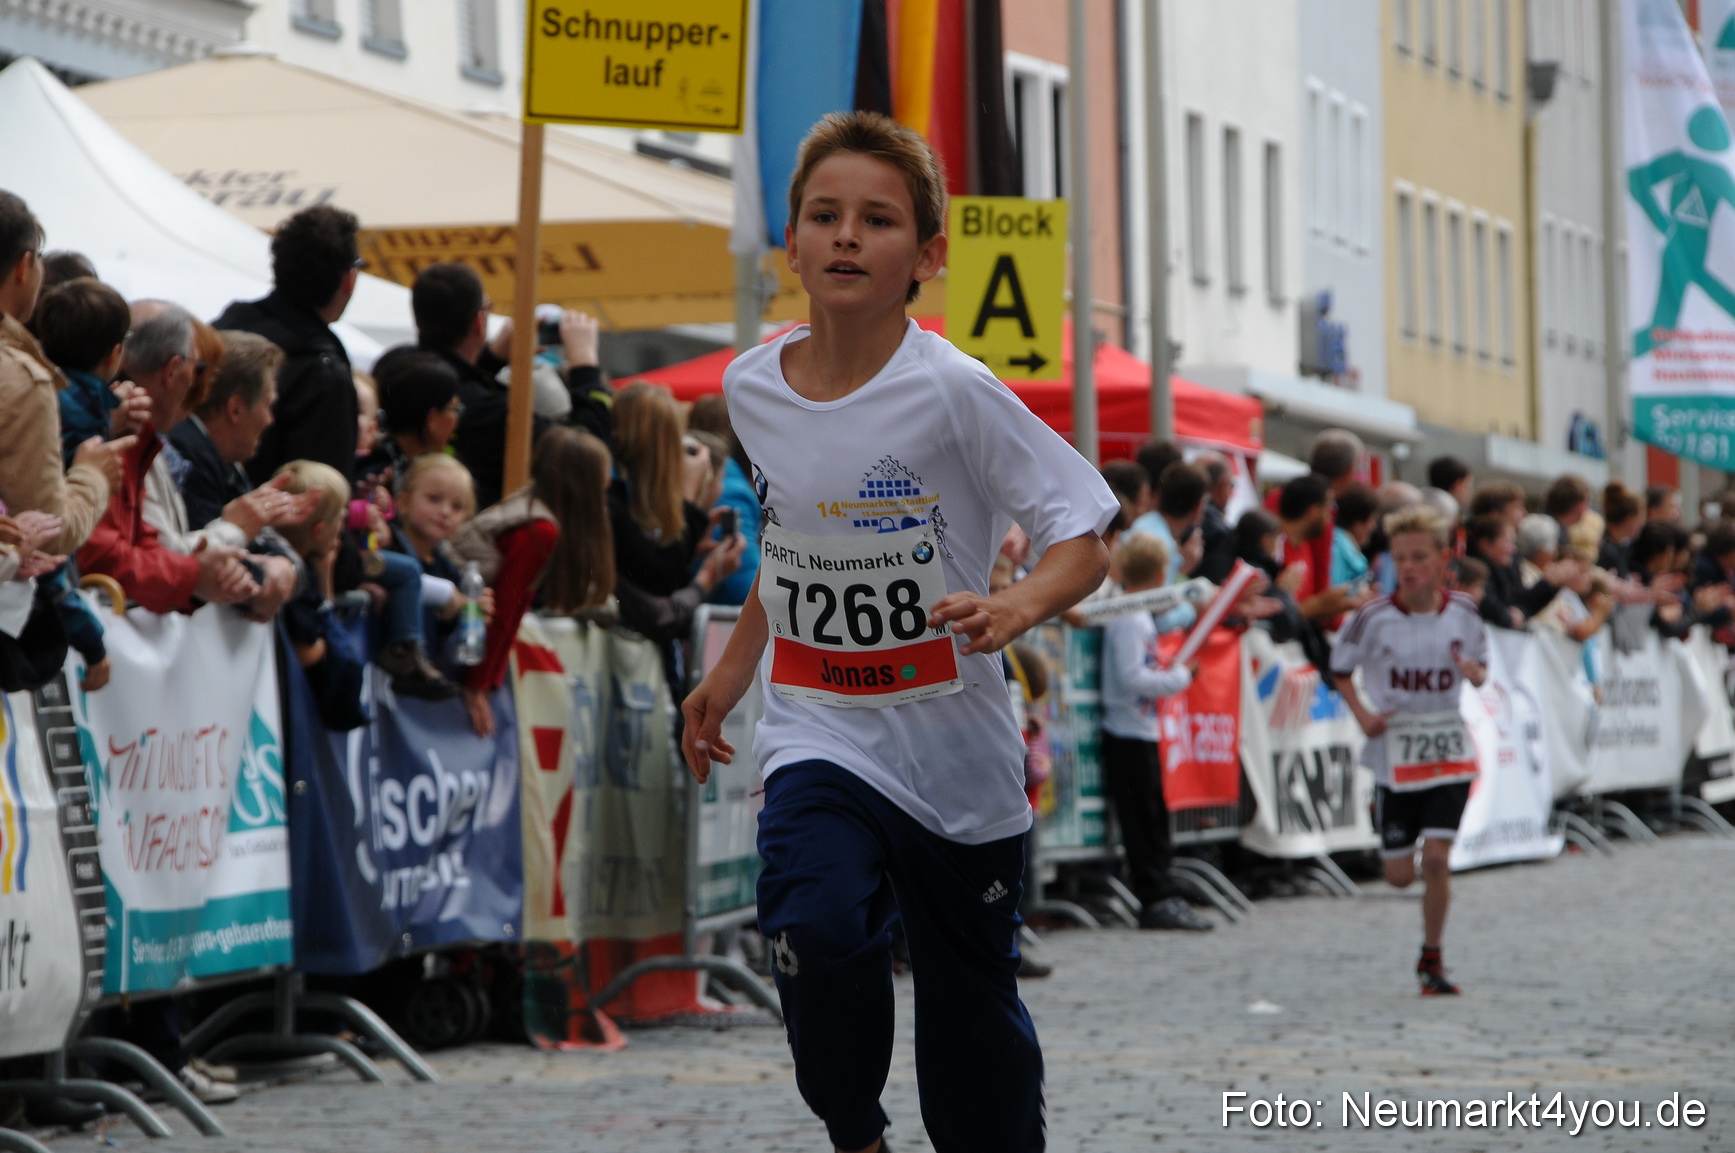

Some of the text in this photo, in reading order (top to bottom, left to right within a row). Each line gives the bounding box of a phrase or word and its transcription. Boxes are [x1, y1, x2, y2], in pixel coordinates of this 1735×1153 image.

[541, 7, 731, 50] Schnupper-
[604, 56, 665, 87] lauf
[961, 205, 1053, 237] Block
[971, 254, 1037, 338] A
[817, 492, 941, 518] 14. Neumarkter Stadtlauf
[765, 541, 904, 572] PARTL Neumarkt
[776, 577, 927, 646] 7268
[775, 624, 782, 634] 6
[821, 658, 895, 688] Jonas
[1391, 667, 1454, 692] NKD
[1399, 731, 1464, 761] 7293
